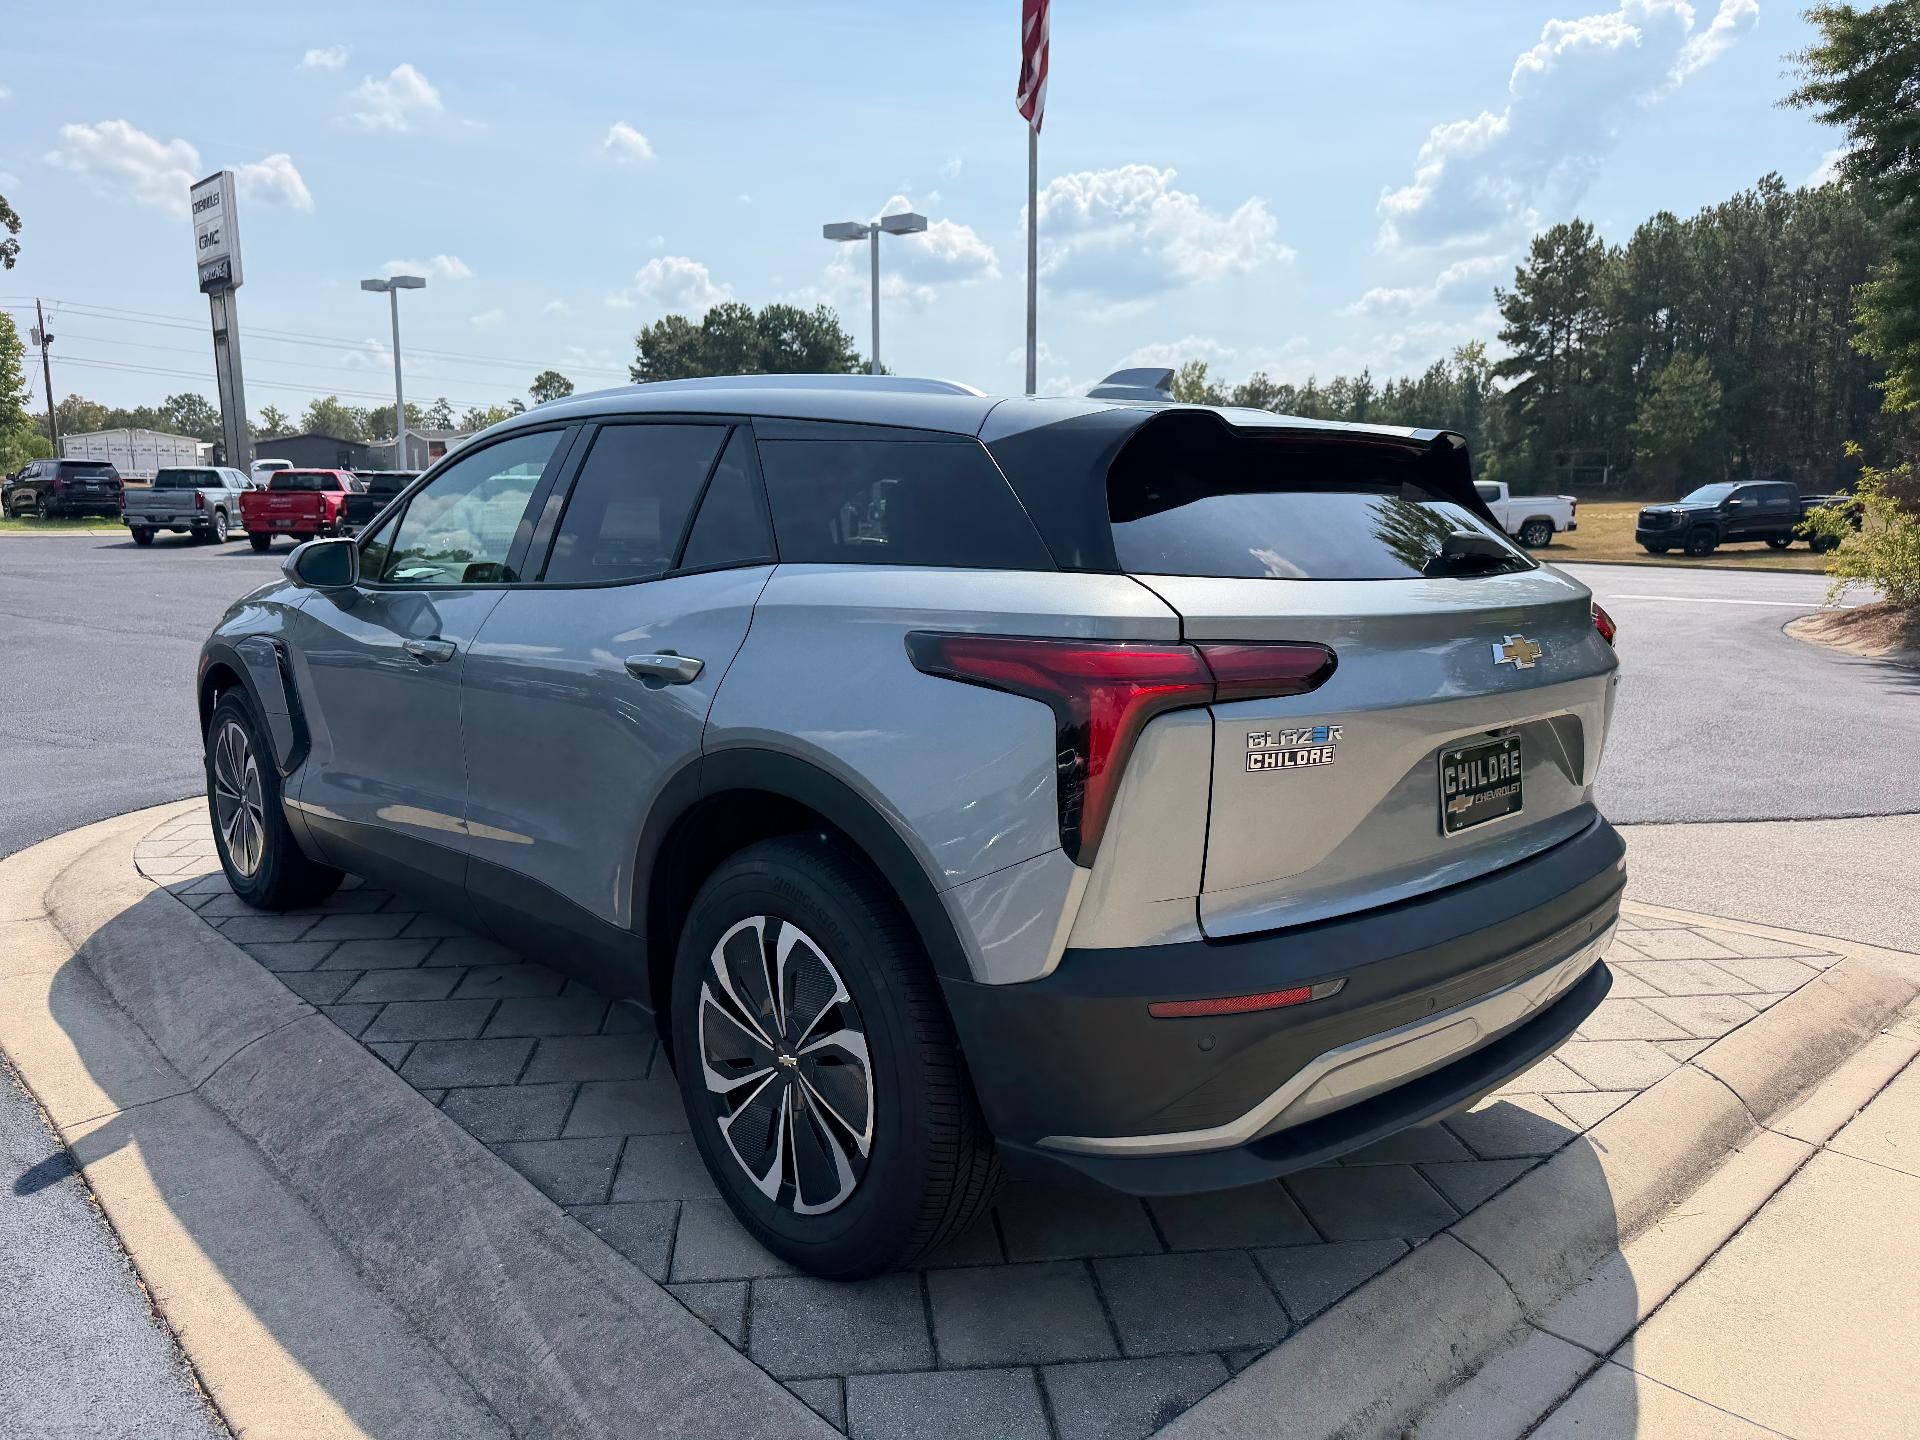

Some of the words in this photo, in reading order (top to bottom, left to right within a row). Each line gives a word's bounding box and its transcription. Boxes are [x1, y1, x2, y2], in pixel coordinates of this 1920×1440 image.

[199, 229, 220, 250] GMC
[1247, 725, 1344, 749] BLAZER
[1249, 748, 1333, 769] CHILDRE
[1445, 750, 1520, 794] CHILDRE
[1475, 782, 1520, 804] CHEVROLET
